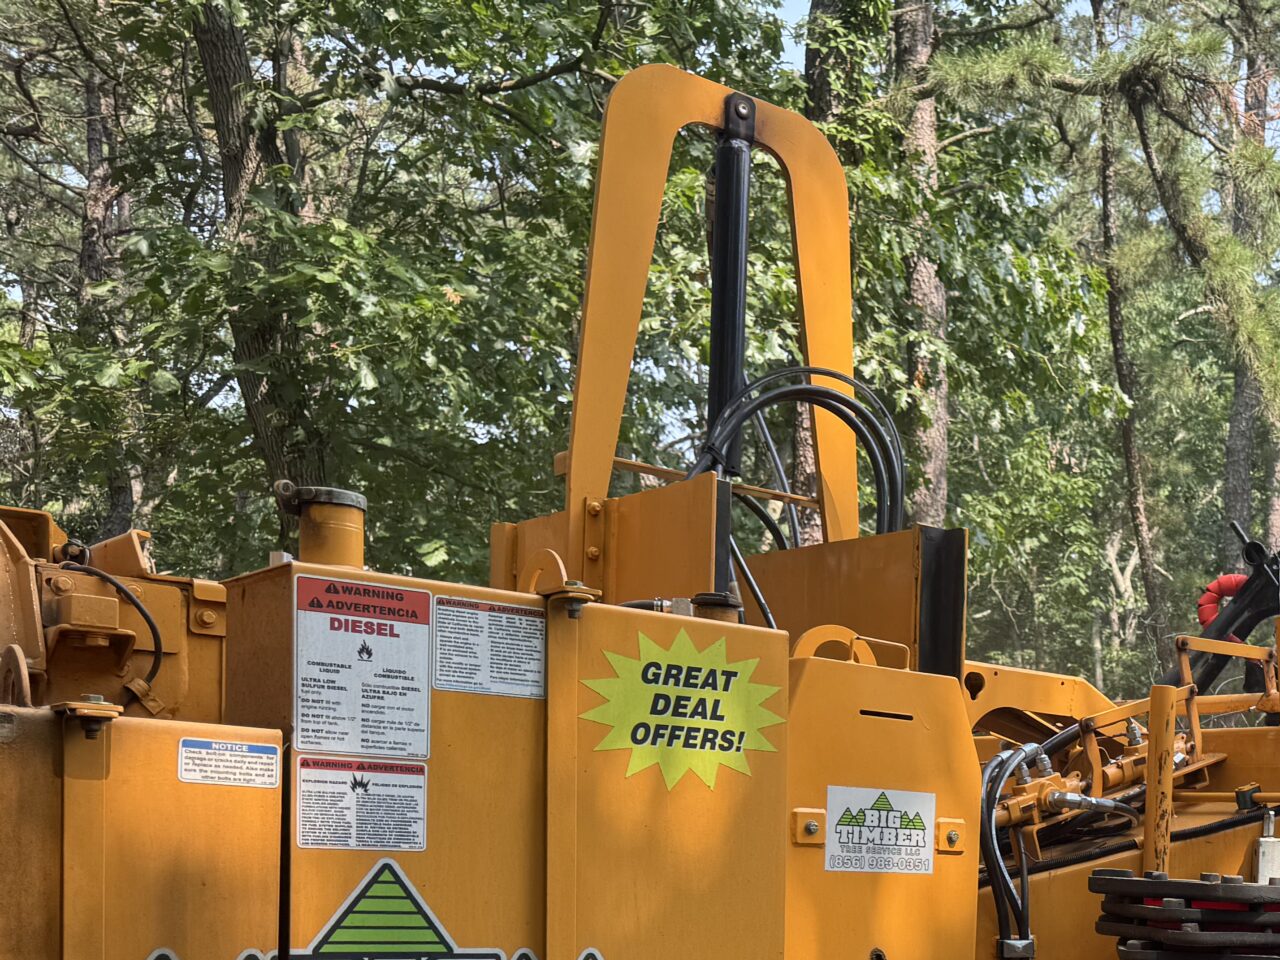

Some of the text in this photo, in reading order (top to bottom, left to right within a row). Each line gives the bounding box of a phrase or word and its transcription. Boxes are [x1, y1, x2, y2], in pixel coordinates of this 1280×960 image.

[341, 585, 404, 602] WARNING
[326, 600, 418, 619] ADVERTENCIA
[445, 599, 480, 609] WARNING
[329, 617, 400, 638] DIESEL
[641, 661, 738, 692] GREAT
[649, 693, 726, 722] DEAL
[630, 721, 746, 752] OFFERS!
[211, 742, 249, 752] NOTICE
[312, 760, 352, 769] WARNING
[367, 763, 425, 773] ADVERTENCIA
[864, 809, 902, 829] BIG
[835, 825, 926, 848] TIMBER
[840, 845, 920, 856] TREE SERVICE LLC
[830, 855, 930, 871] (856) 983-0351
